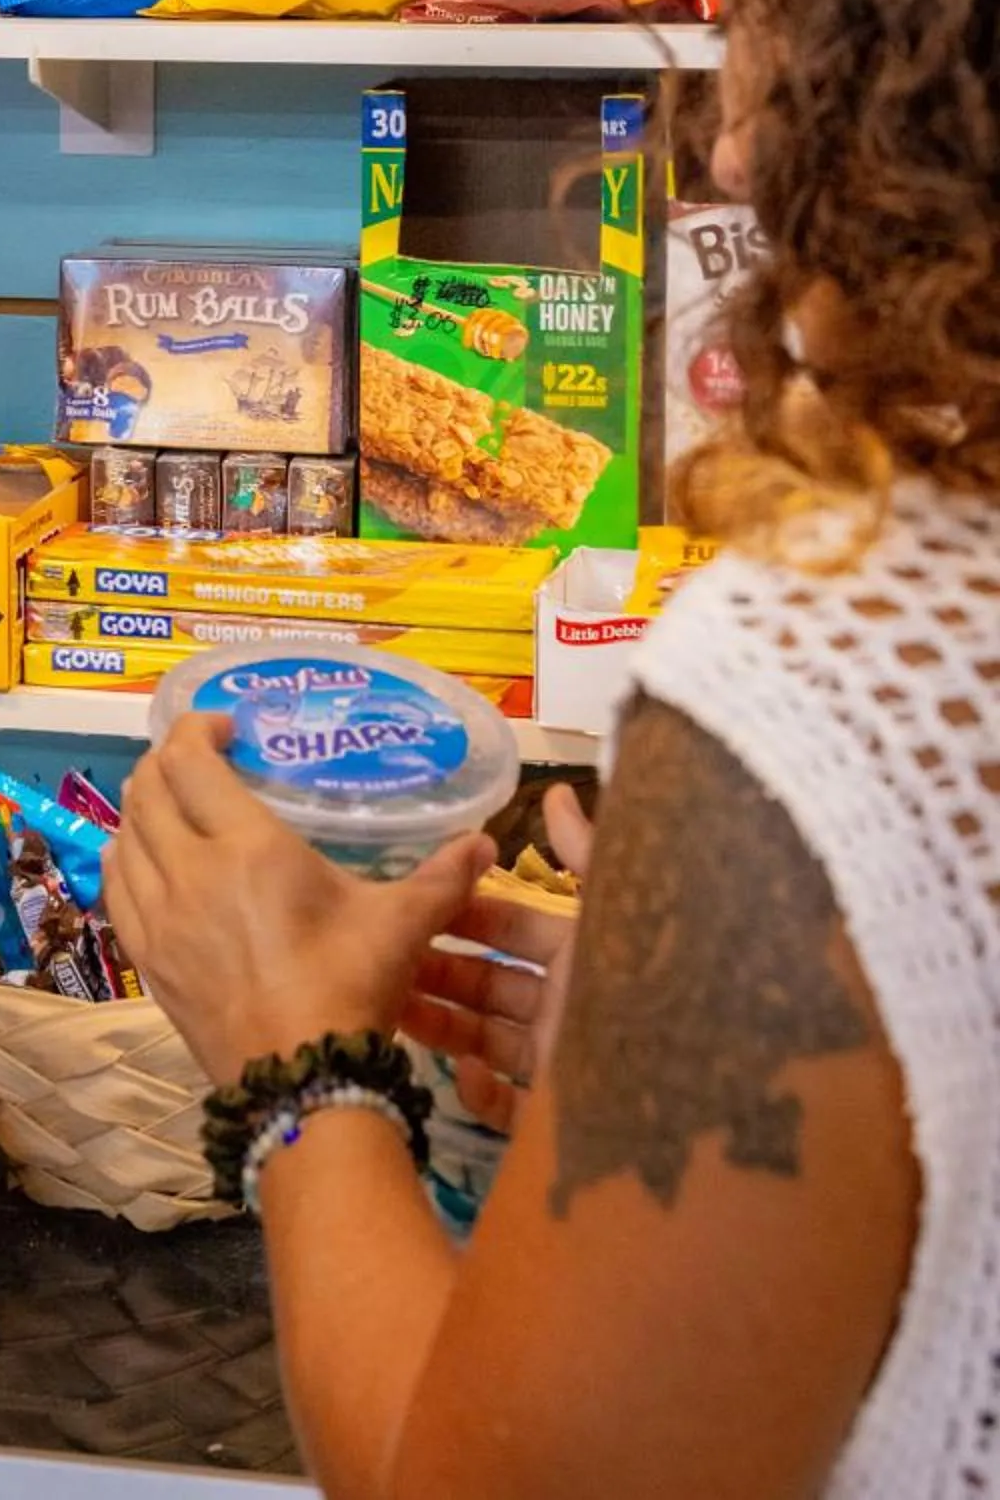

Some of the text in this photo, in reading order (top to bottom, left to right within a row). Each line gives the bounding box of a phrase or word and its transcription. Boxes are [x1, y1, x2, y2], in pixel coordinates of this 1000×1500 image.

[371, 109, 406, 139] 30
[540, 274, 598, 301] OATS
[102, 283, 310, 333] RUM BALLS
[540, 303, 615, 333] HONEY
[98, 571, 166, 595] GOYA
[193, 582, 366, 612] MANGO WAFERS
[102, 614, 171, 637] GOYA
[560, 620, 646, 642] Little Debb
[53, 649, 122, 672] GOYA
